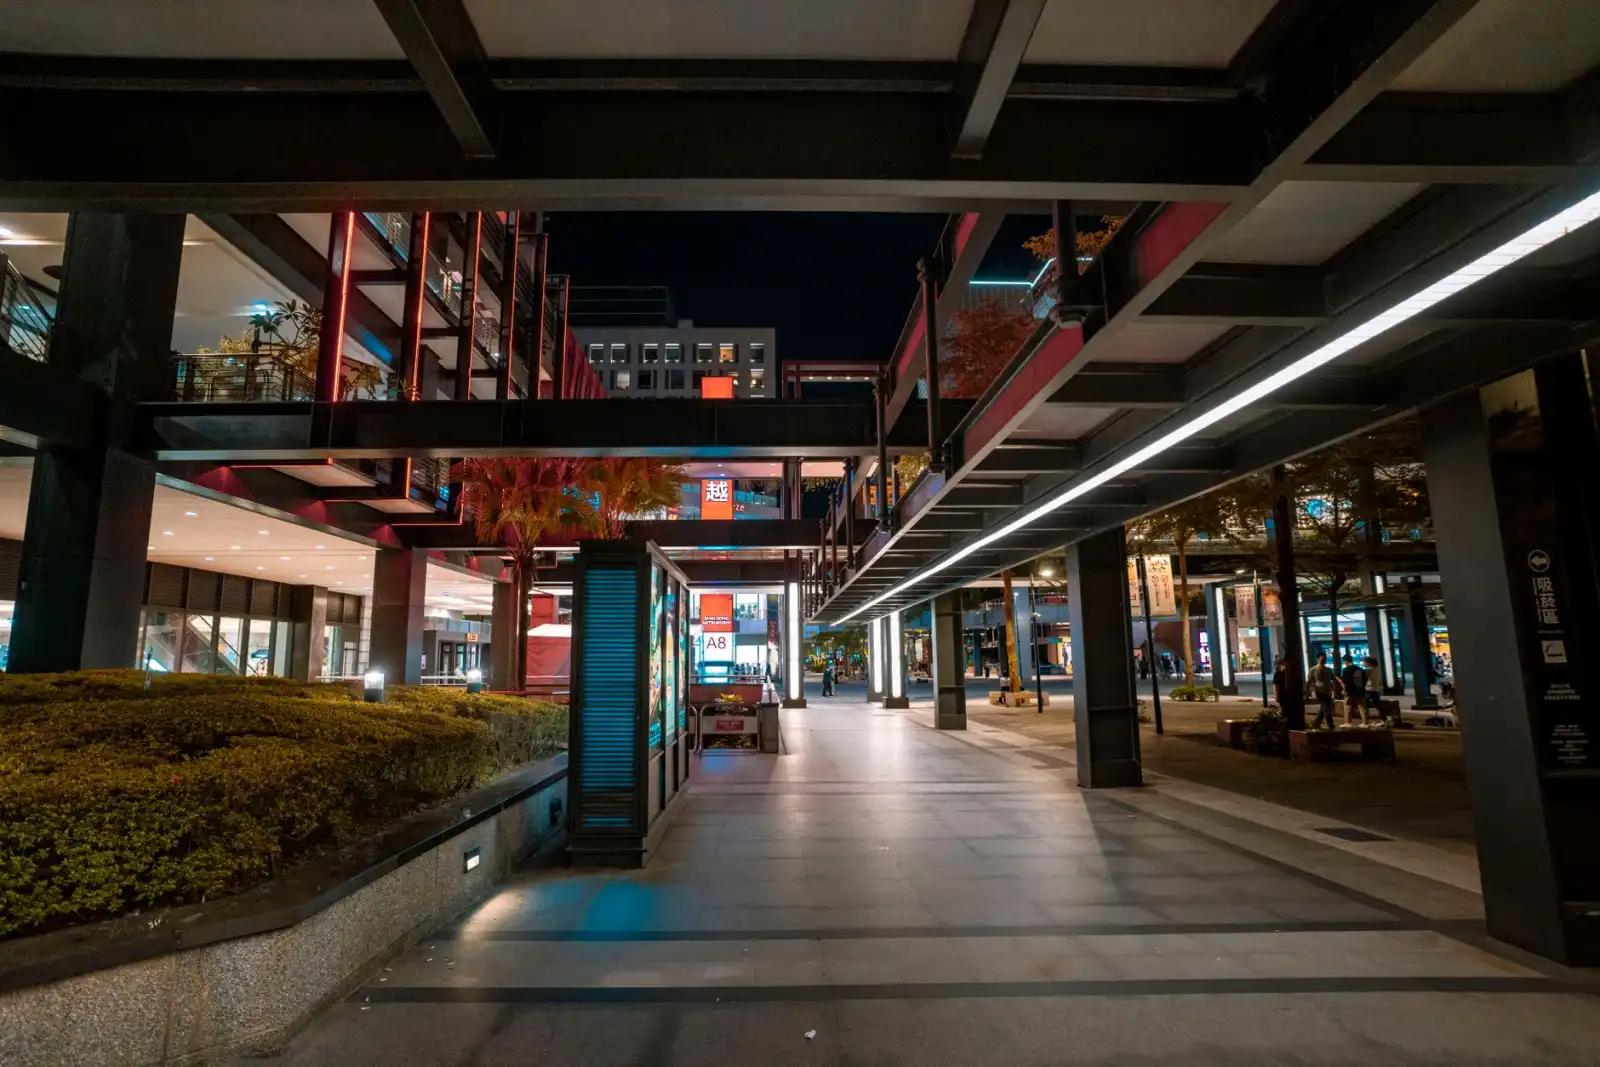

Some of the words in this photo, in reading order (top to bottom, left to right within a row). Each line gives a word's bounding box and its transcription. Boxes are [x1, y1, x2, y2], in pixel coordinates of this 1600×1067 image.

[705, 480, 728, 502] 越
[1537, 576, 1560, 624] 吸菸區
[706, 636, 727, 650] A8
